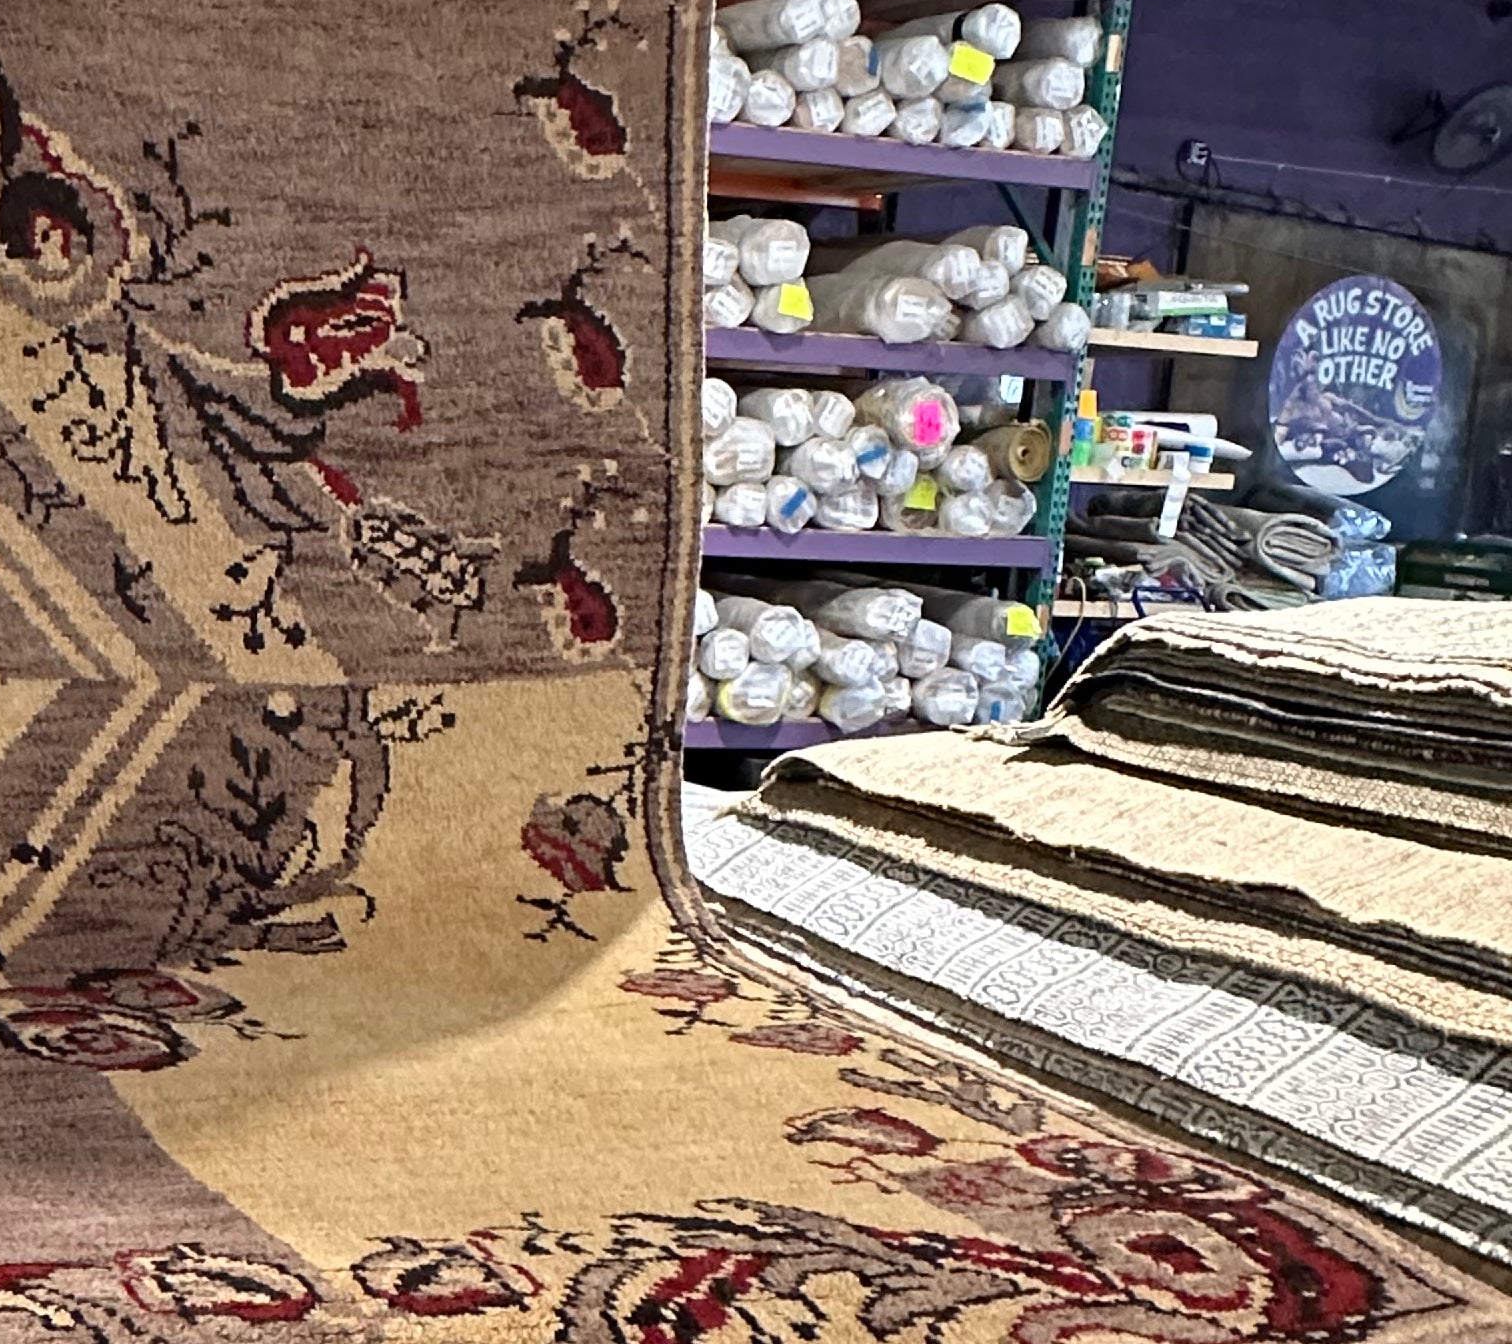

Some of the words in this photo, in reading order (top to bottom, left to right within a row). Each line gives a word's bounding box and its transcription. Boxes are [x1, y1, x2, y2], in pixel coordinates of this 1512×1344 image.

[1296, 318, 1318, 347] A
[1313, 288, 1362, 327] RUG
[1365, 289, 1433, 356] STORE
[1321, 326, 1369, 355] LIKE
[1371, 328, 1406, 360] NO
[1318, 355, 1398, 390] OTHER
